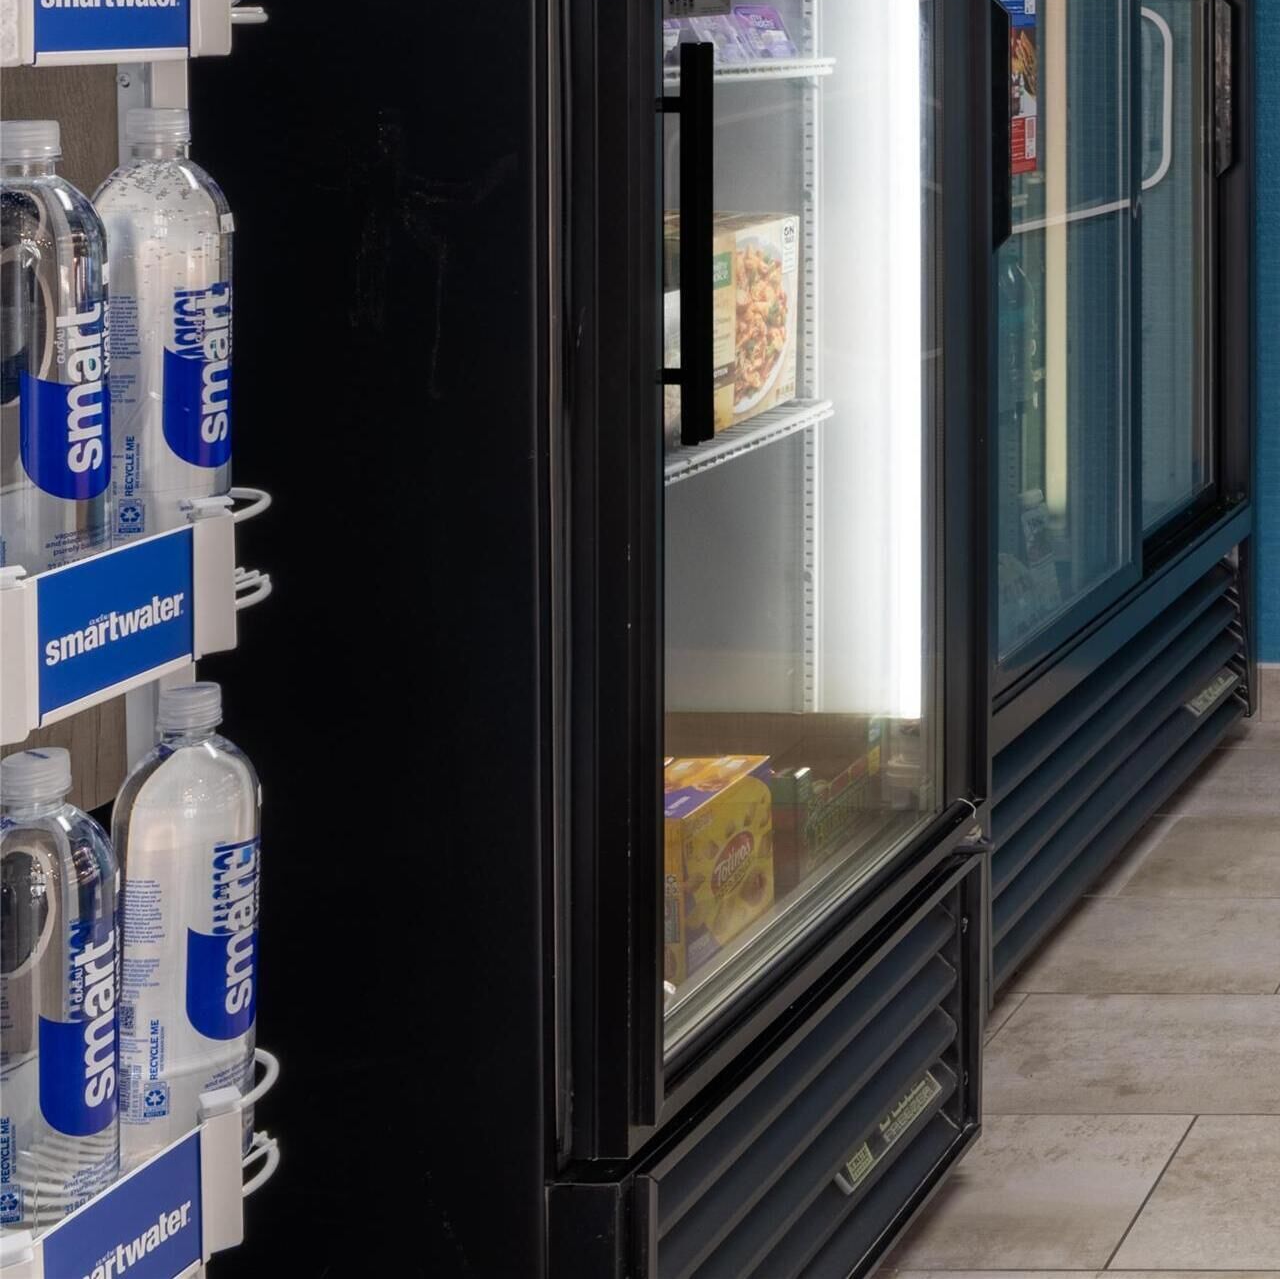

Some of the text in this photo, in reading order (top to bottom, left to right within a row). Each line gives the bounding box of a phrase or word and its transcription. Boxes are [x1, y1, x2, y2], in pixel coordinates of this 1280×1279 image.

[57, 302, 103, 473] smart
[201, 287, 229, 444] smart
[125, 436, 135, 496] RECYCLE ME
[45, 593, 184, 666] smartwater
[225, 849, 254, 1015] smart
[75, 932, 114, 1109] smart
[150, 1019, 159, 1080] RECYCLE ME
[1, 1138, 9, 1184] RECYCLE
[82, 1200, 192, 1279] artwater
